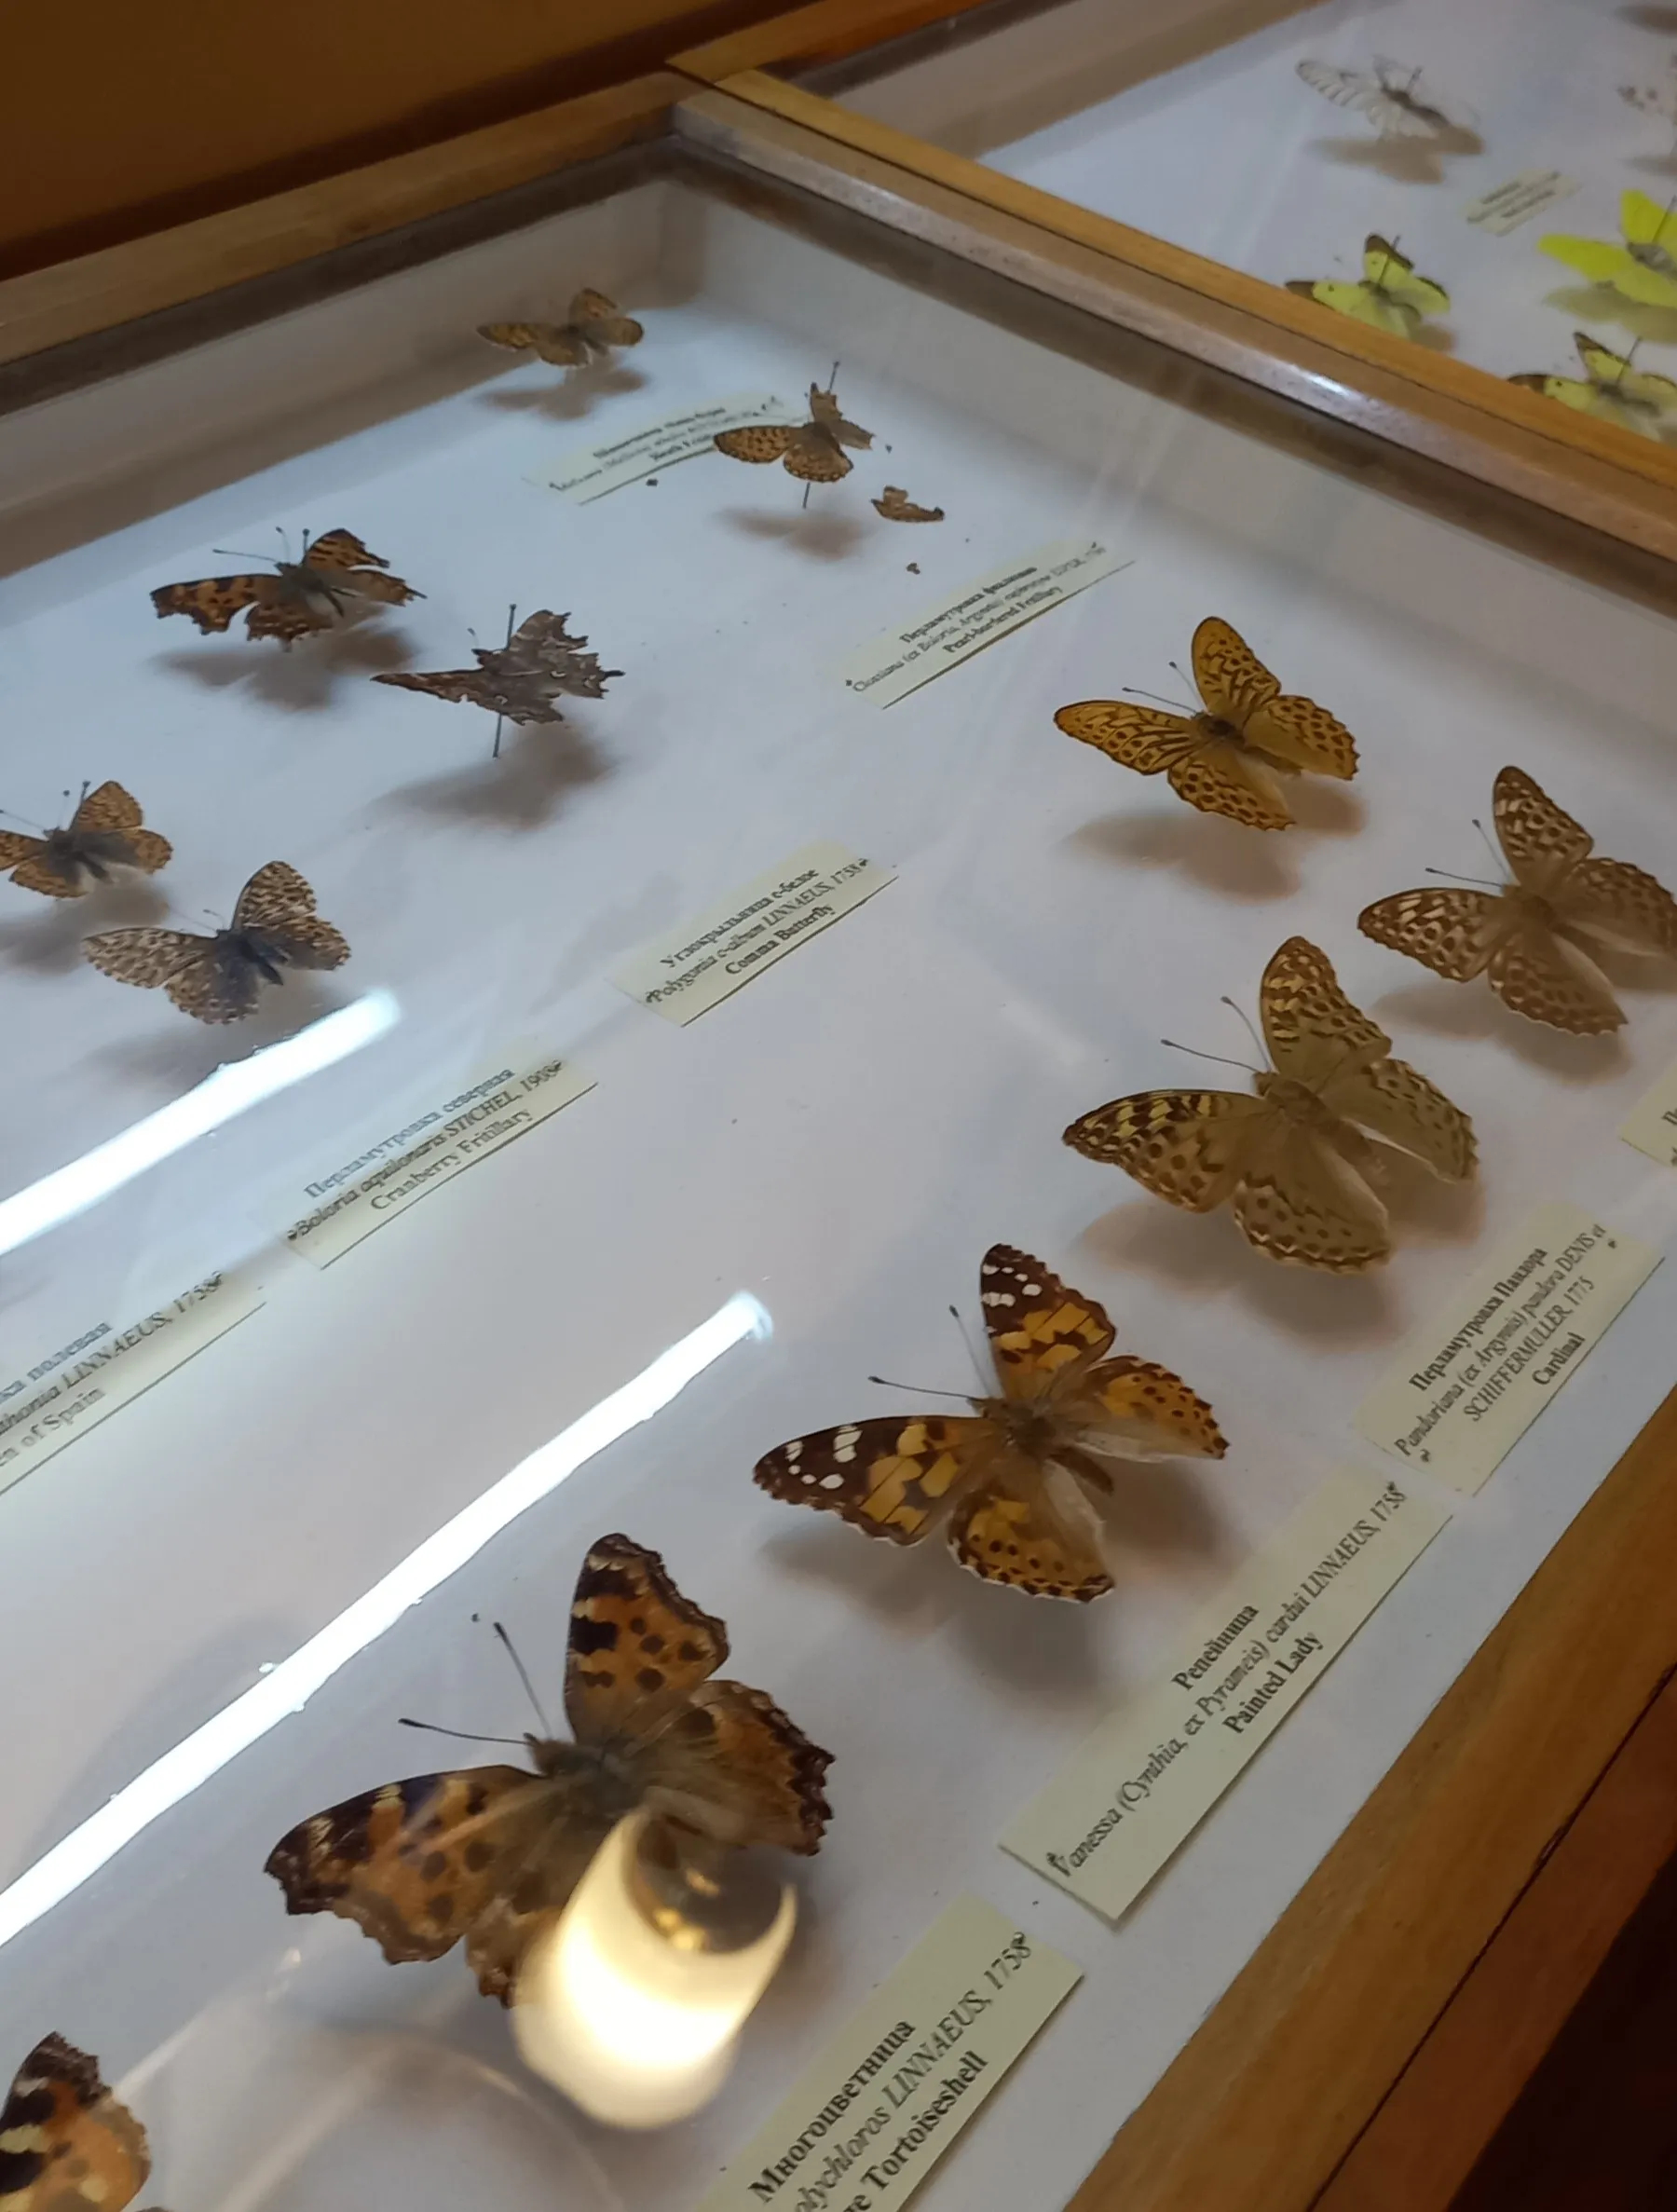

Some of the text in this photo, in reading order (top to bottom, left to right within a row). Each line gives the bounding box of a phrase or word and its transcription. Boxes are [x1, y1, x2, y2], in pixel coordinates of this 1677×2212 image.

[725, 904, 836, 975] Comma Butterfly
[371, 1109, 533, 1209] Cranberry Fritillary
[1532, 1331, 1586, 1386] Cardinal
[21, 1424, 45, 1447] of
[43, 1387, 106, 1430] Spain
[1171, 1604, 1259, 1691] Репейница
[1223, 1632, 1324, 1734] Painted Lady
[1048, 1808, 1123, 1877] Vanessa
[1184, 1714, 1205, 1737] ex
[1266, 1593, 1310, 1644] cardui
[748, 2020, 916, 2204] Многоцветница
[861, 2050, 988, 2191] Tortoiseshell
